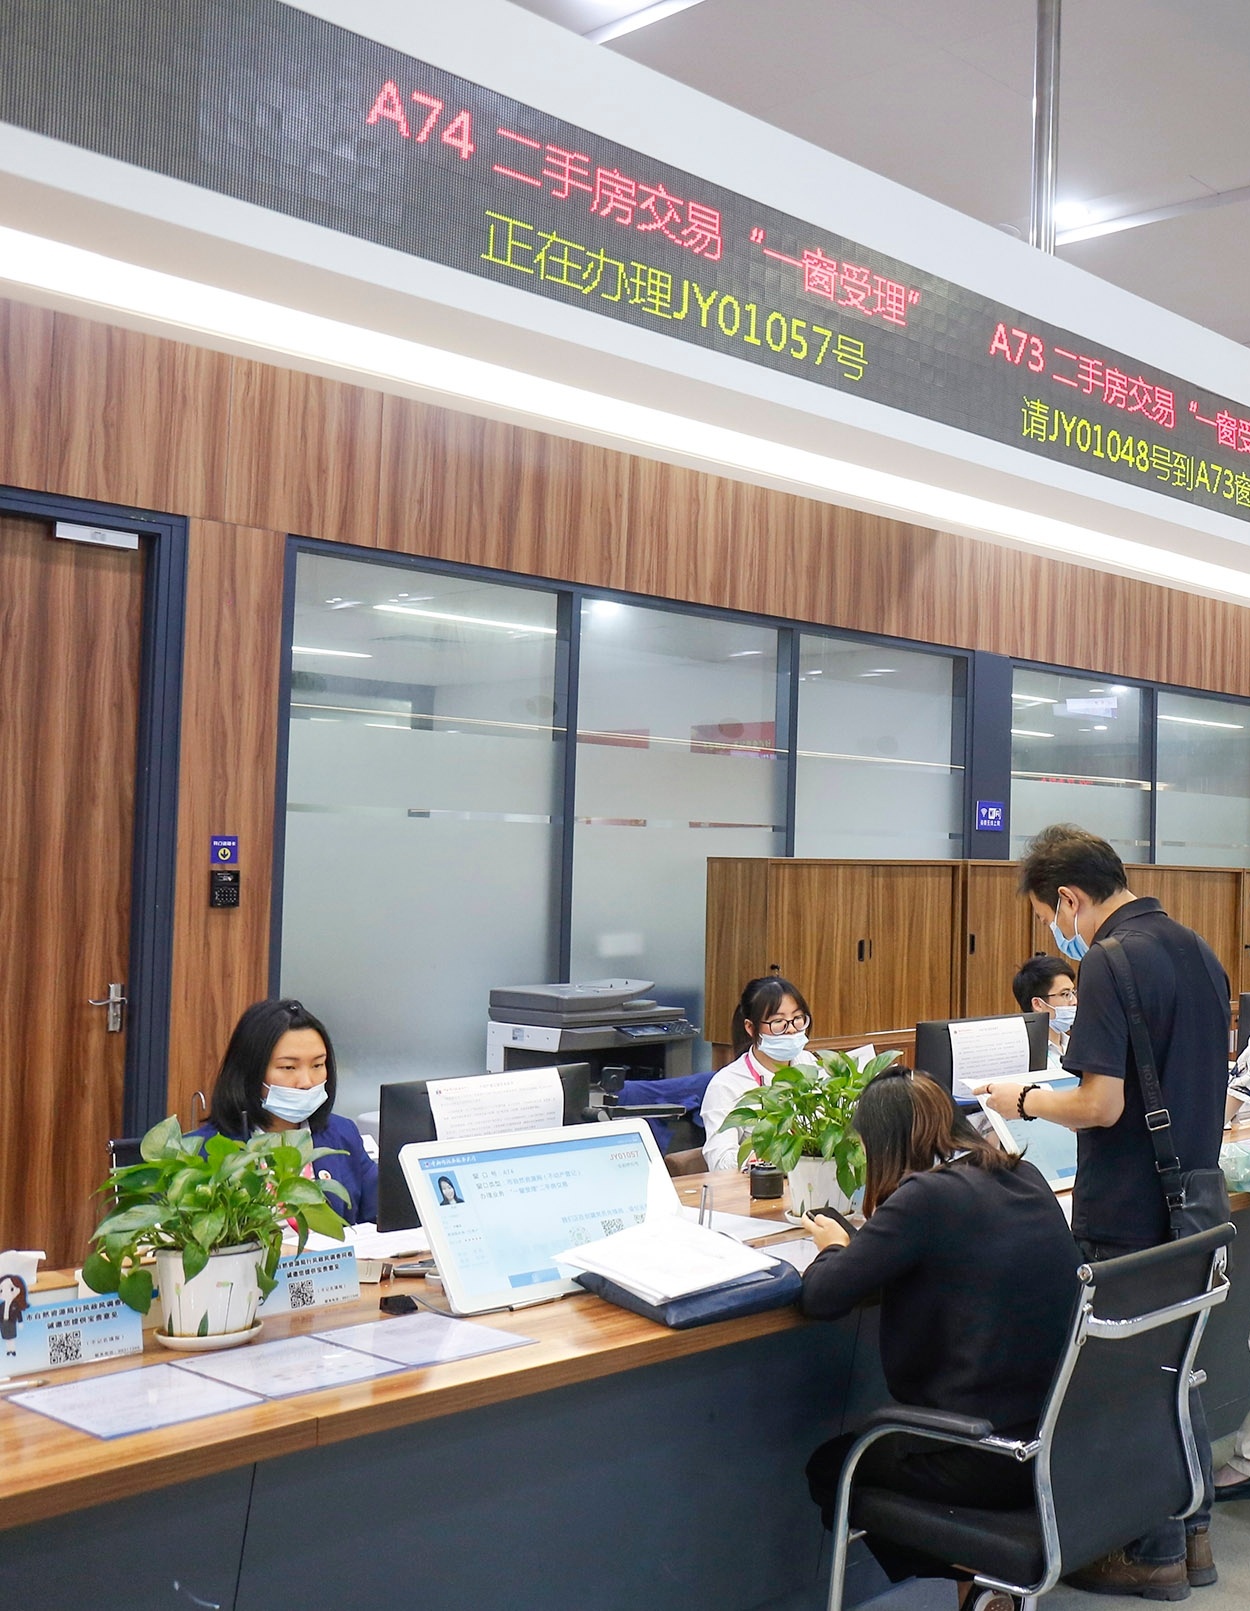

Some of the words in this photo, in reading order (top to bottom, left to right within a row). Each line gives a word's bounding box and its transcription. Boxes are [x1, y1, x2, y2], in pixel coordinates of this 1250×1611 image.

[366, 80, 474, 160] A74
[493, 127, 724, 261] 二手房交易
[481, 210, 869, 382] 正在办理JY01057号
[989, 323, 1045, 372] A73
[1052, 347, 1176, 430] 二手房交易
[610, 1151, 639, 1160] JY01057
